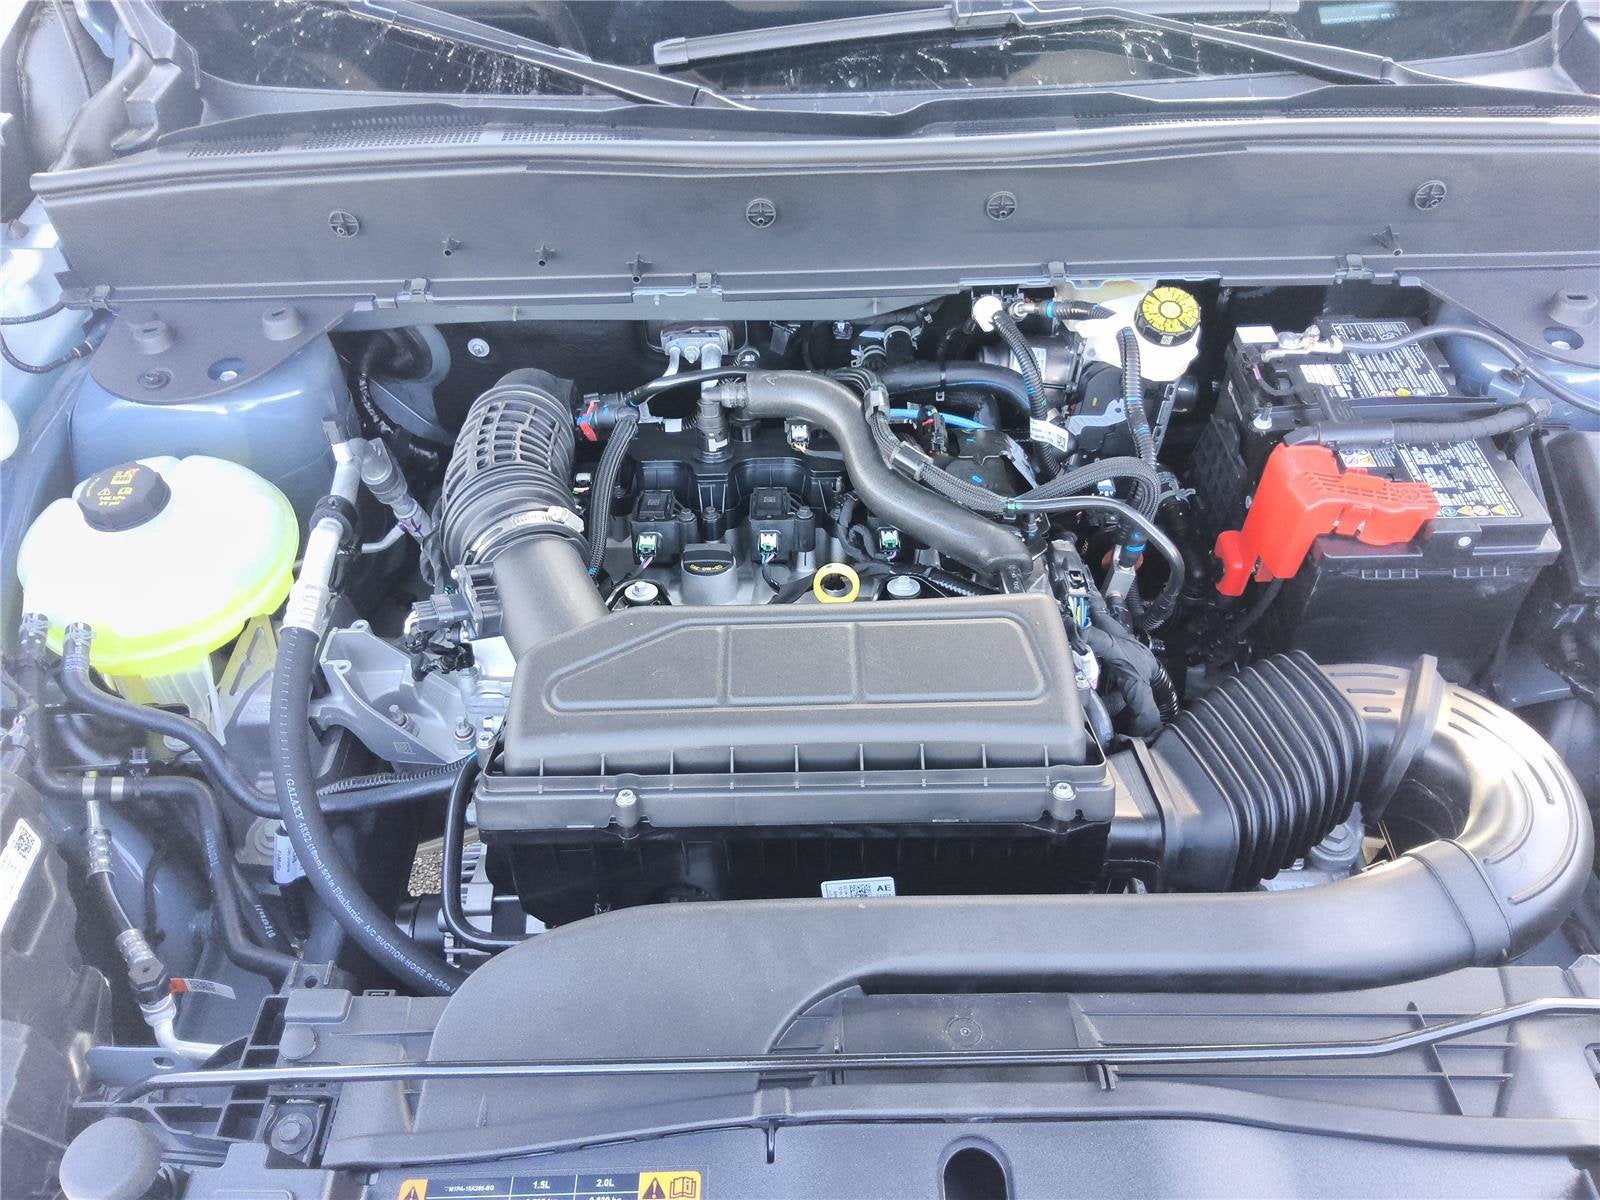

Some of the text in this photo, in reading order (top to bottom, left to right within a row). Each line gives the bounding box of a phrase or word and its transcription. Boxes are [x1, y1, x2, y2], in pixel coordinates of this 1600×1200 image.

[286, 778, 305, 820] GALAXY
[363, 924, 378, 937] A/C
[375, 935, 407, 963] SUCTION
[404, 959, 427, 977] HOSE
[876, 884, 892, 892] AE
[532, 1180, 551, 1190] 1.5L
[596, 1178, 615, 1188] 2.0L
